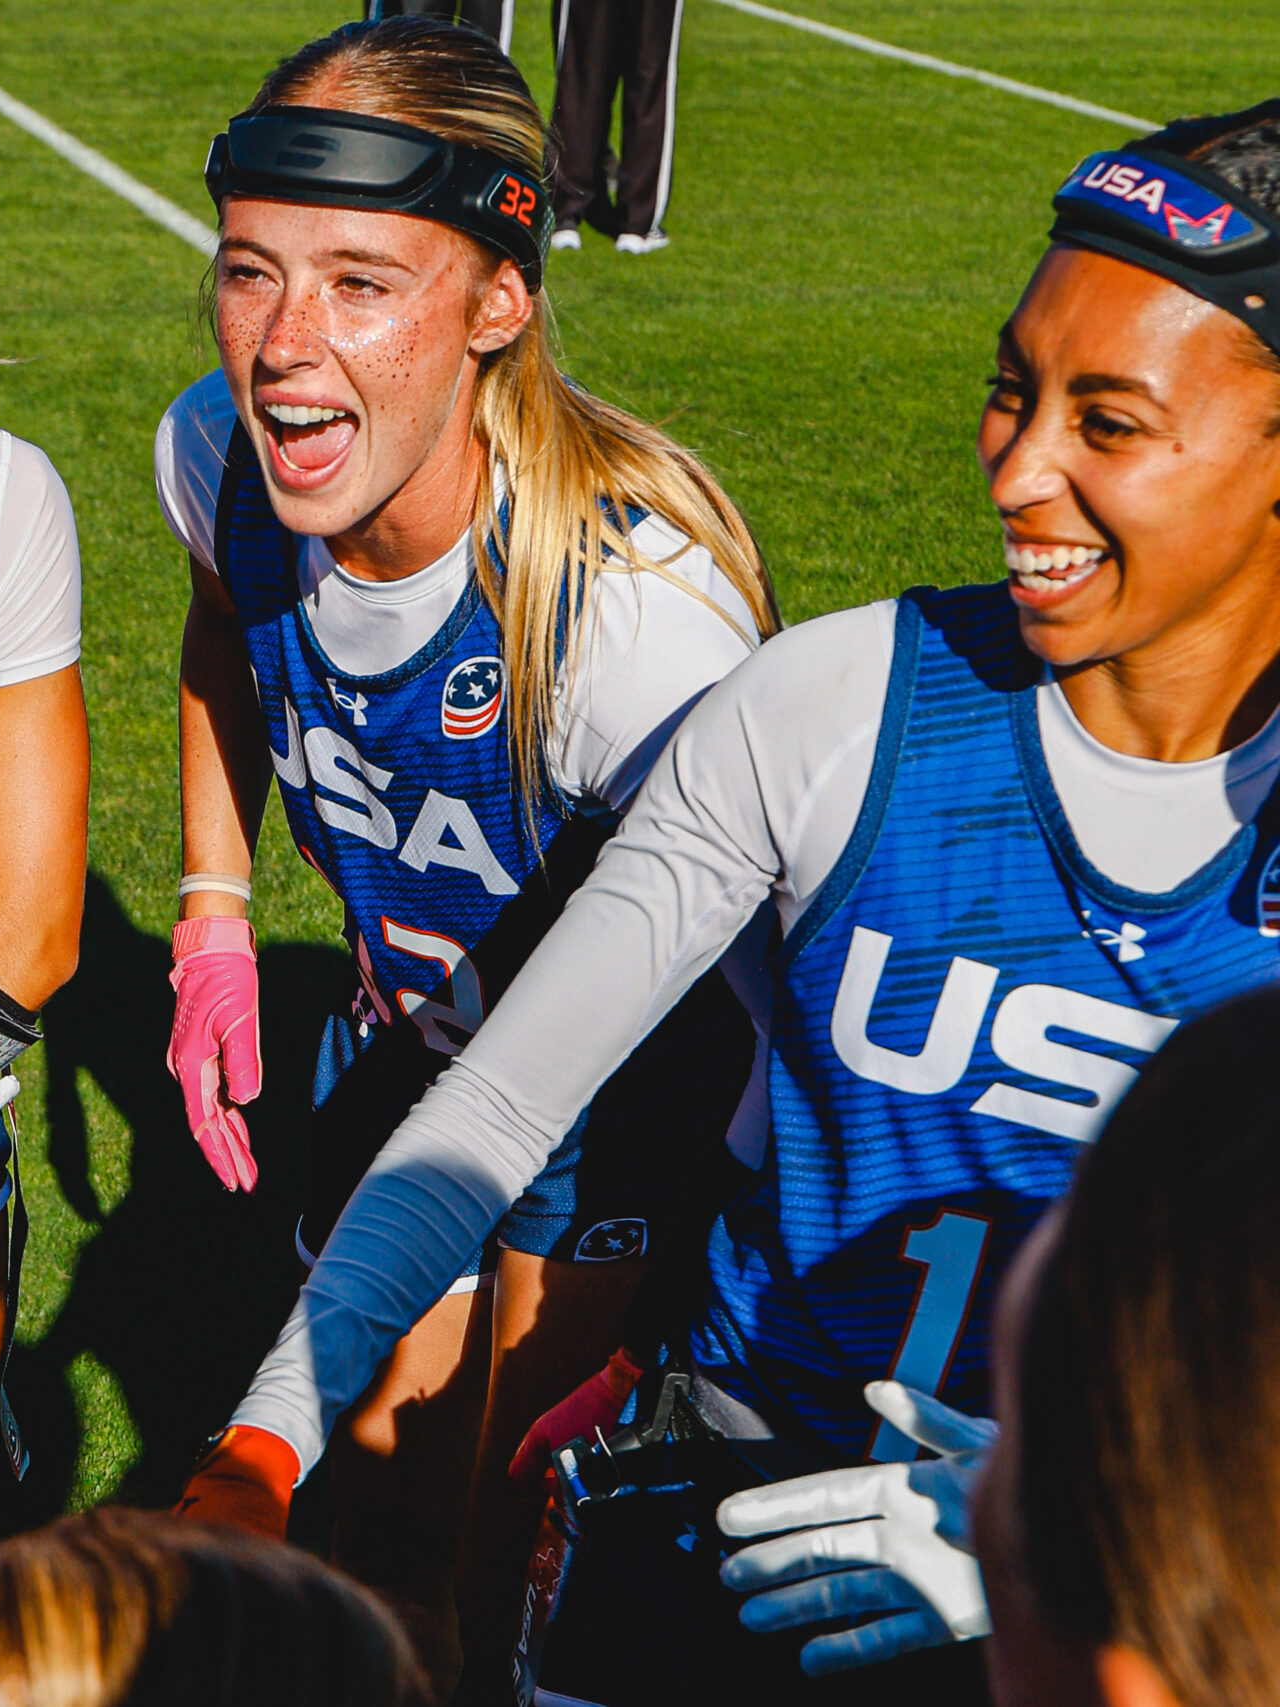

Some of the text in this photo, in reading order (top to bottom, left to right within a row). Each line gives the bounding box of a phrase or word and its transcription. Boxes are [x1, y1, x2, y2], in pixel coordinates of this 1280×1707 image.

[499, 175, 536, 227] 32
[1083, 161, 1166, 215] USA
[829, 925, 1182, 1146] US
